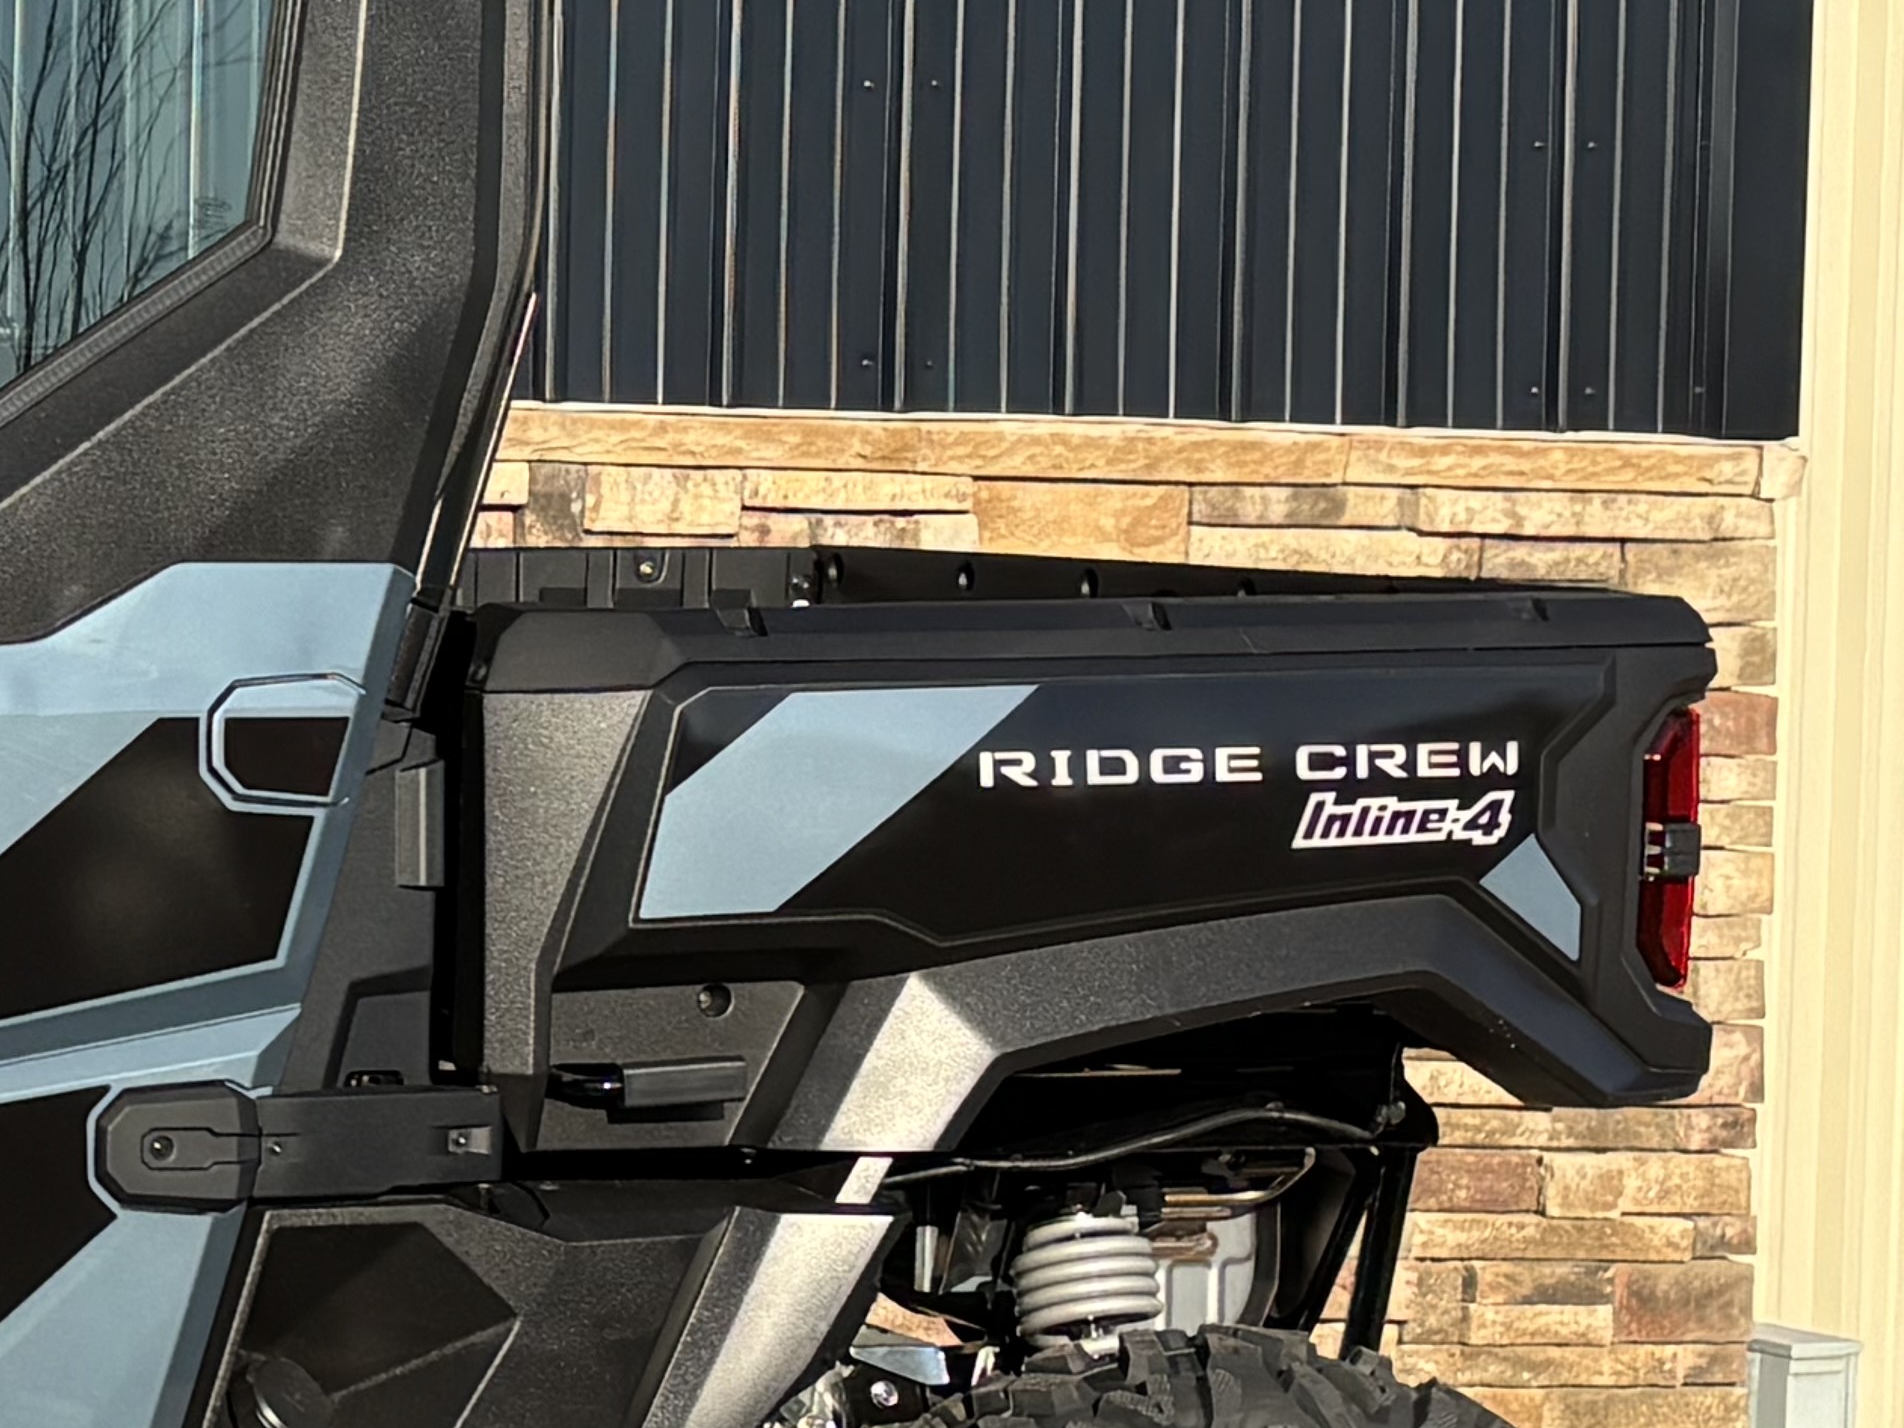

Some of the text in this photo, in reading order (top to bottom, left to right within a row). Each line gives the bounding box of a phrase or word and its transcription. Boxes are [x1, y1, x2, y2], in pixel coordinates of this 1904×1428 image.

[978, 740, 1519, 789] RIDGE CREW
[1296, 792, 1511, 846] Inline-4
